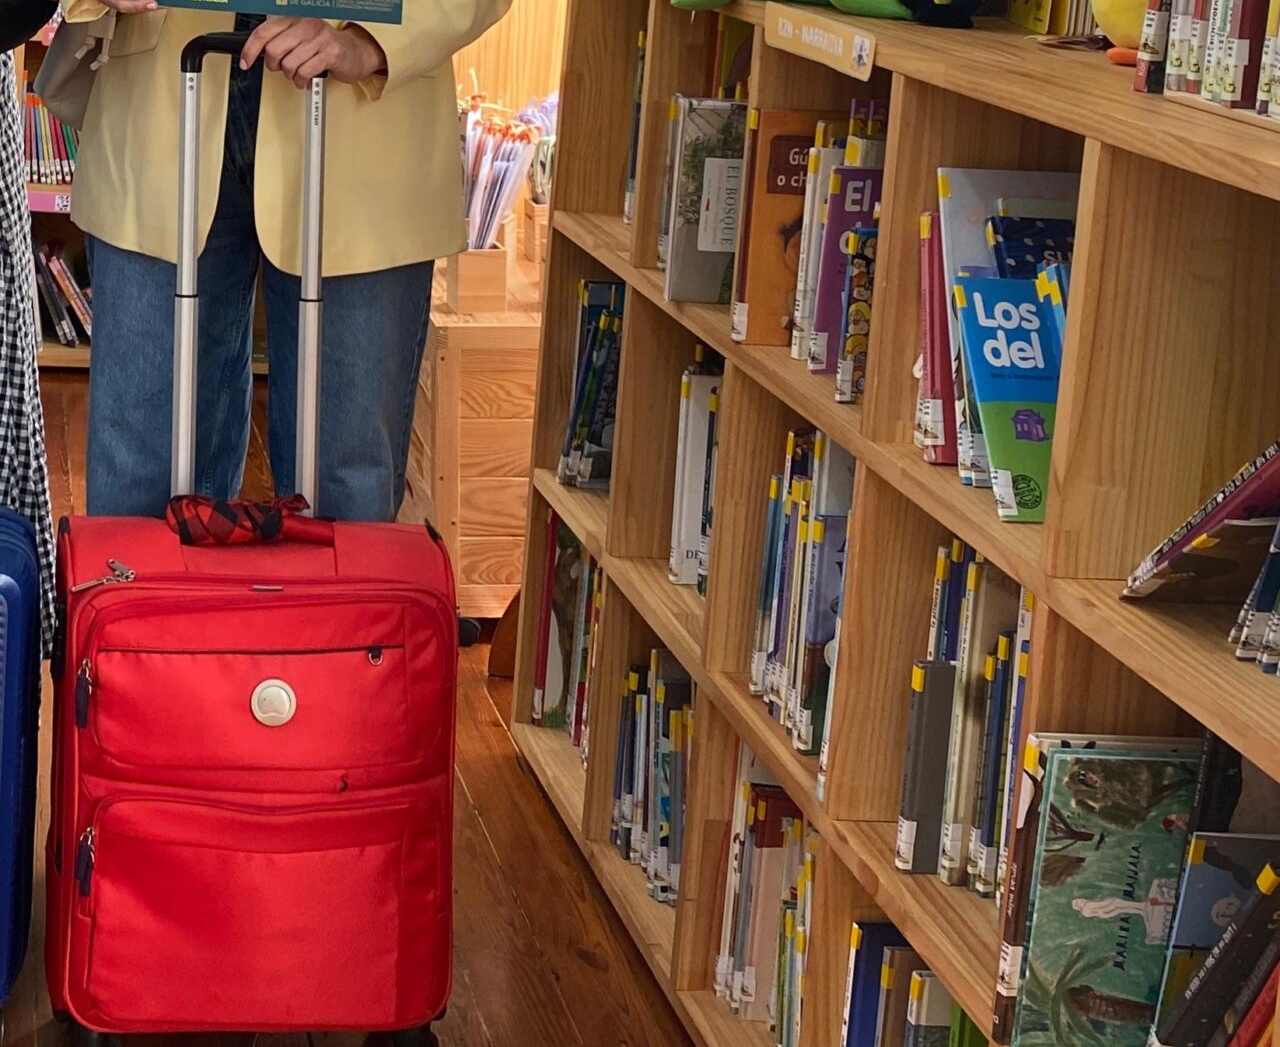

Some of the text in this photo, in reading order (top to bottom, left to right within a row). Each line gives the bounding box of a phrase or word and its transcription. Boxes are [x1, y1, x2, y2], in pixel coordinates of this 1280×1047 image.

[300, 0, 330, 7] GALICIA
[776, 174, 786, 186] o
[844, 180, 871, 213] El
[720, 187, 739, 245] BOSQUE
[972, 291, 1041, 331] Los
[983, 330, 1045, 369] del
